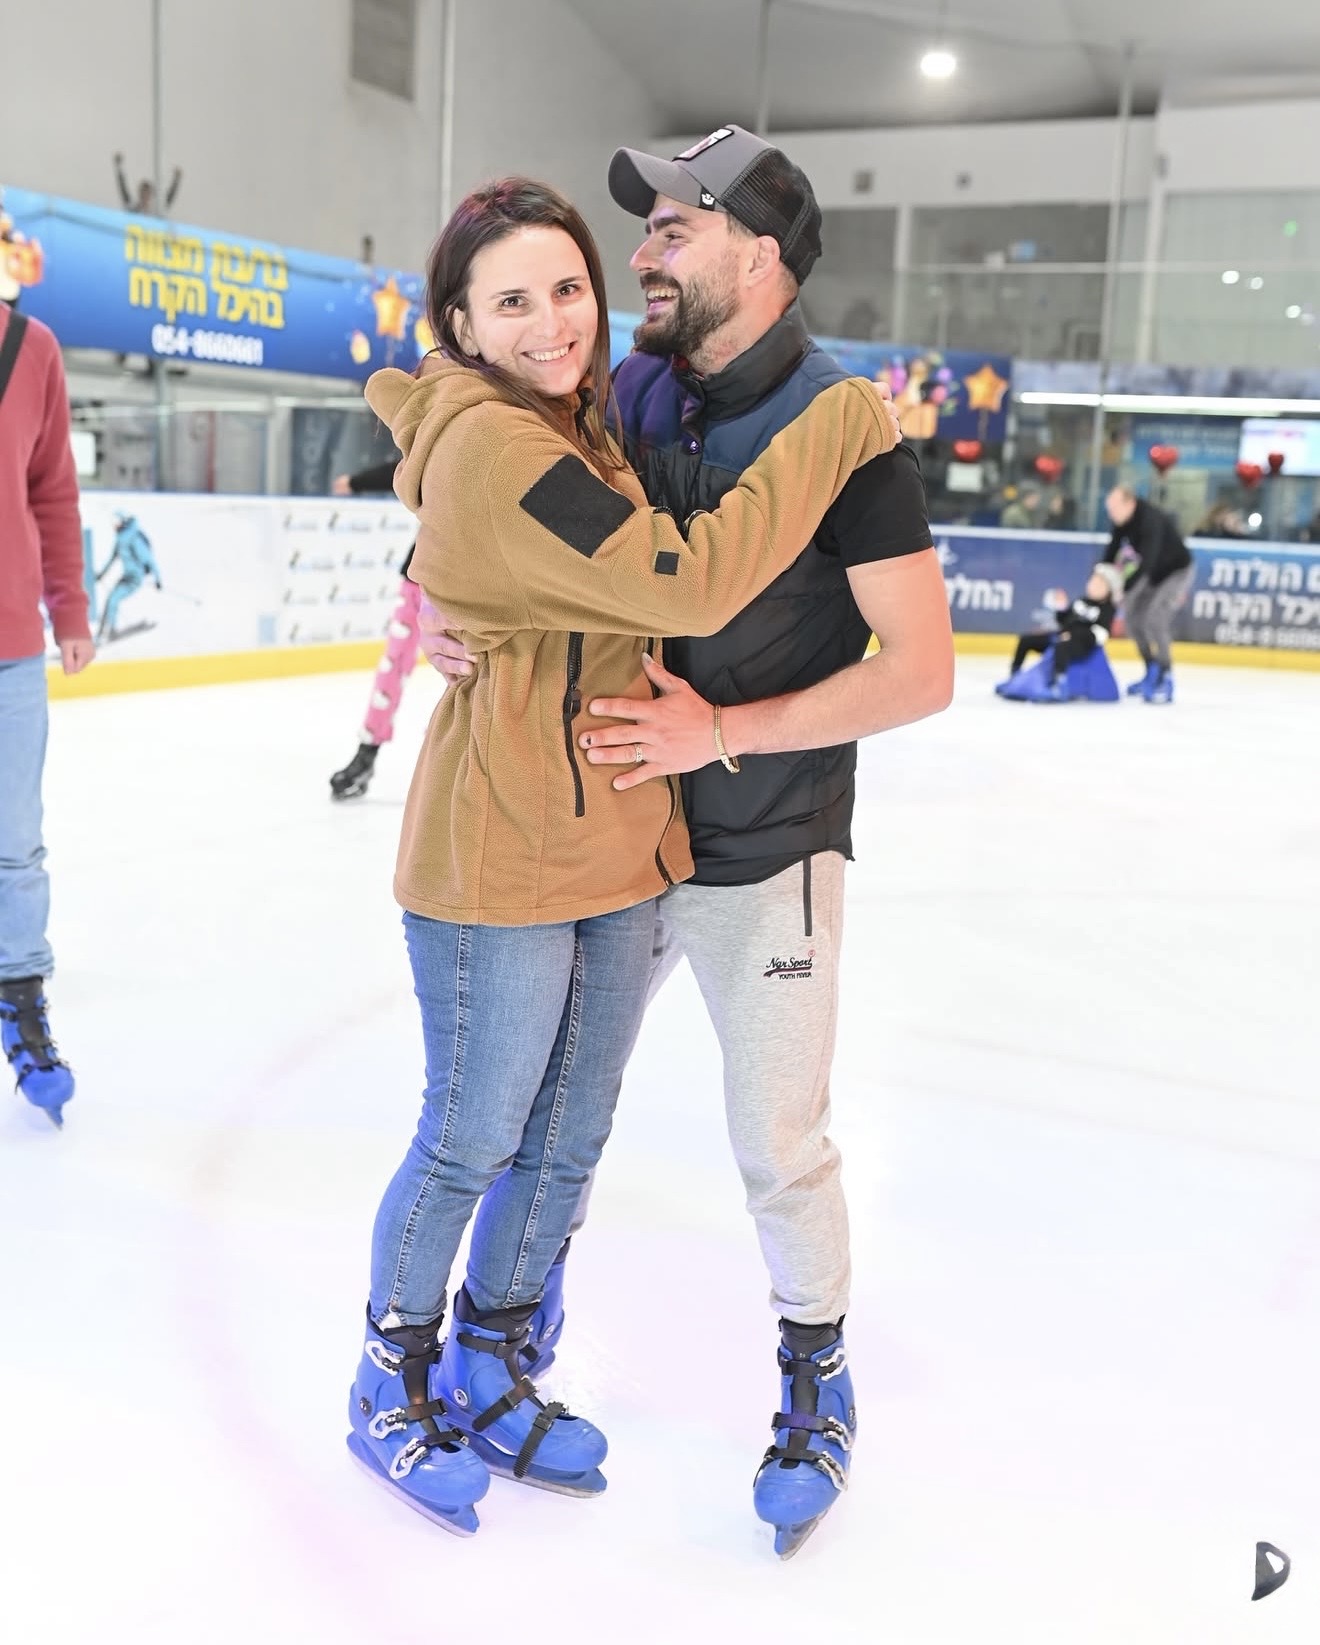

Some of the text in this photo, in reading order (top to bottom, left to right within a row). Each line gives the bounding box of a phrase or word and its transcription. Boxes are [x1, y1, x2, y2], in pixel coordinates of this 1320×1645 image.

[129, 267, 285, 329] בהיכל הקרח
[1208, 557, 1303, 592] הולדת
[1193, 590, 1272, 632] הקרח
